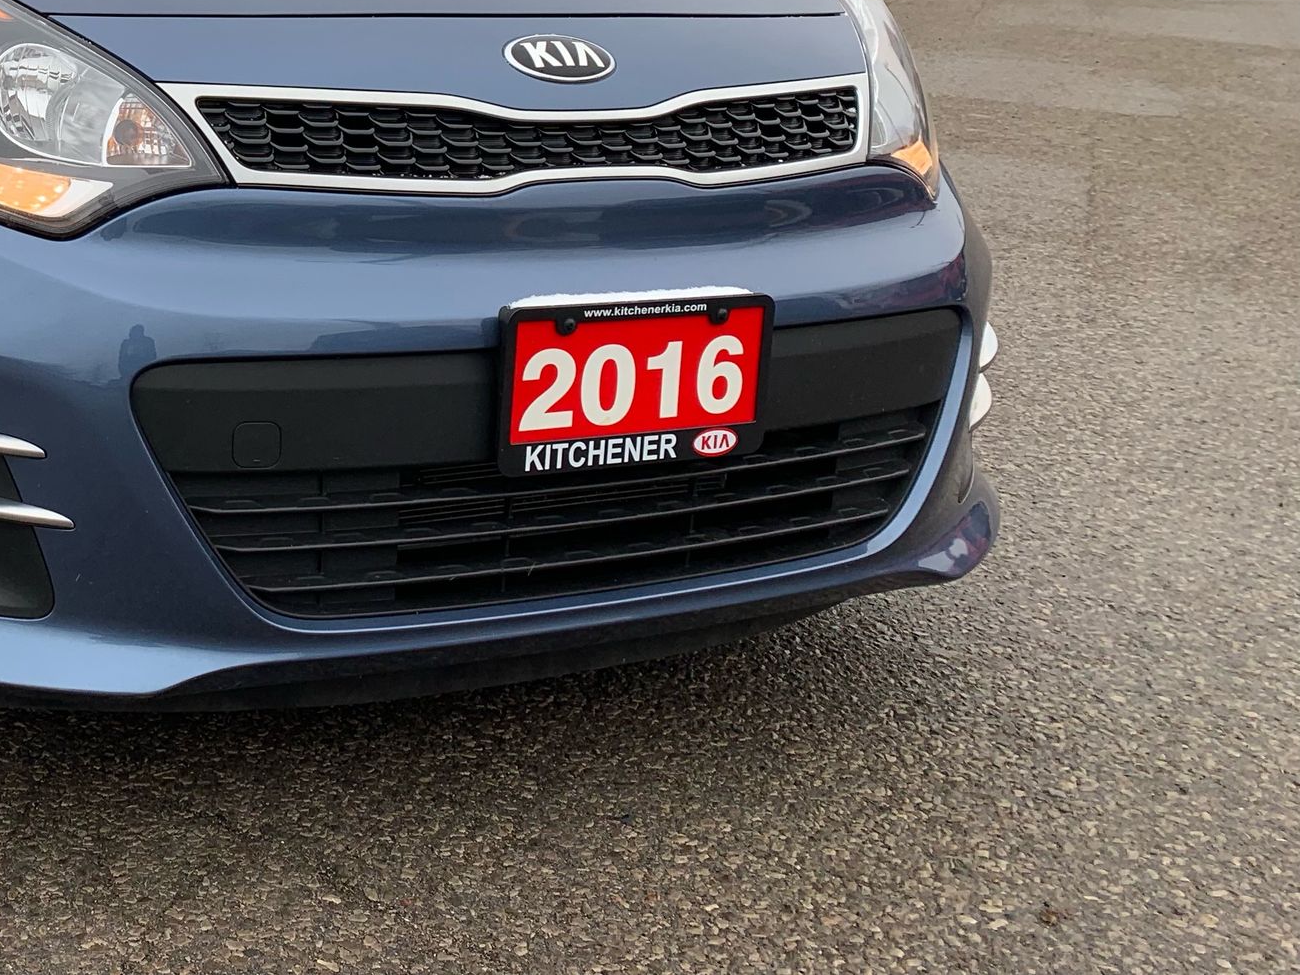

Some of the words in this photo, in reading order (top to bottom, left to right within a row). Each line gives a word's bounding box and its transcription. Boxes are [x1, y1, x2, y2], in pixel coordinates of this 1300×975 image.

[520, 40, 606, 68] KIA
[583, 303, 708, 318] www.kitchenerkia.com
[518, 334, 745, 433] 2016
[524, 433, 678, 472] KITCHENER
[700, 429, 732, 451] KIA
